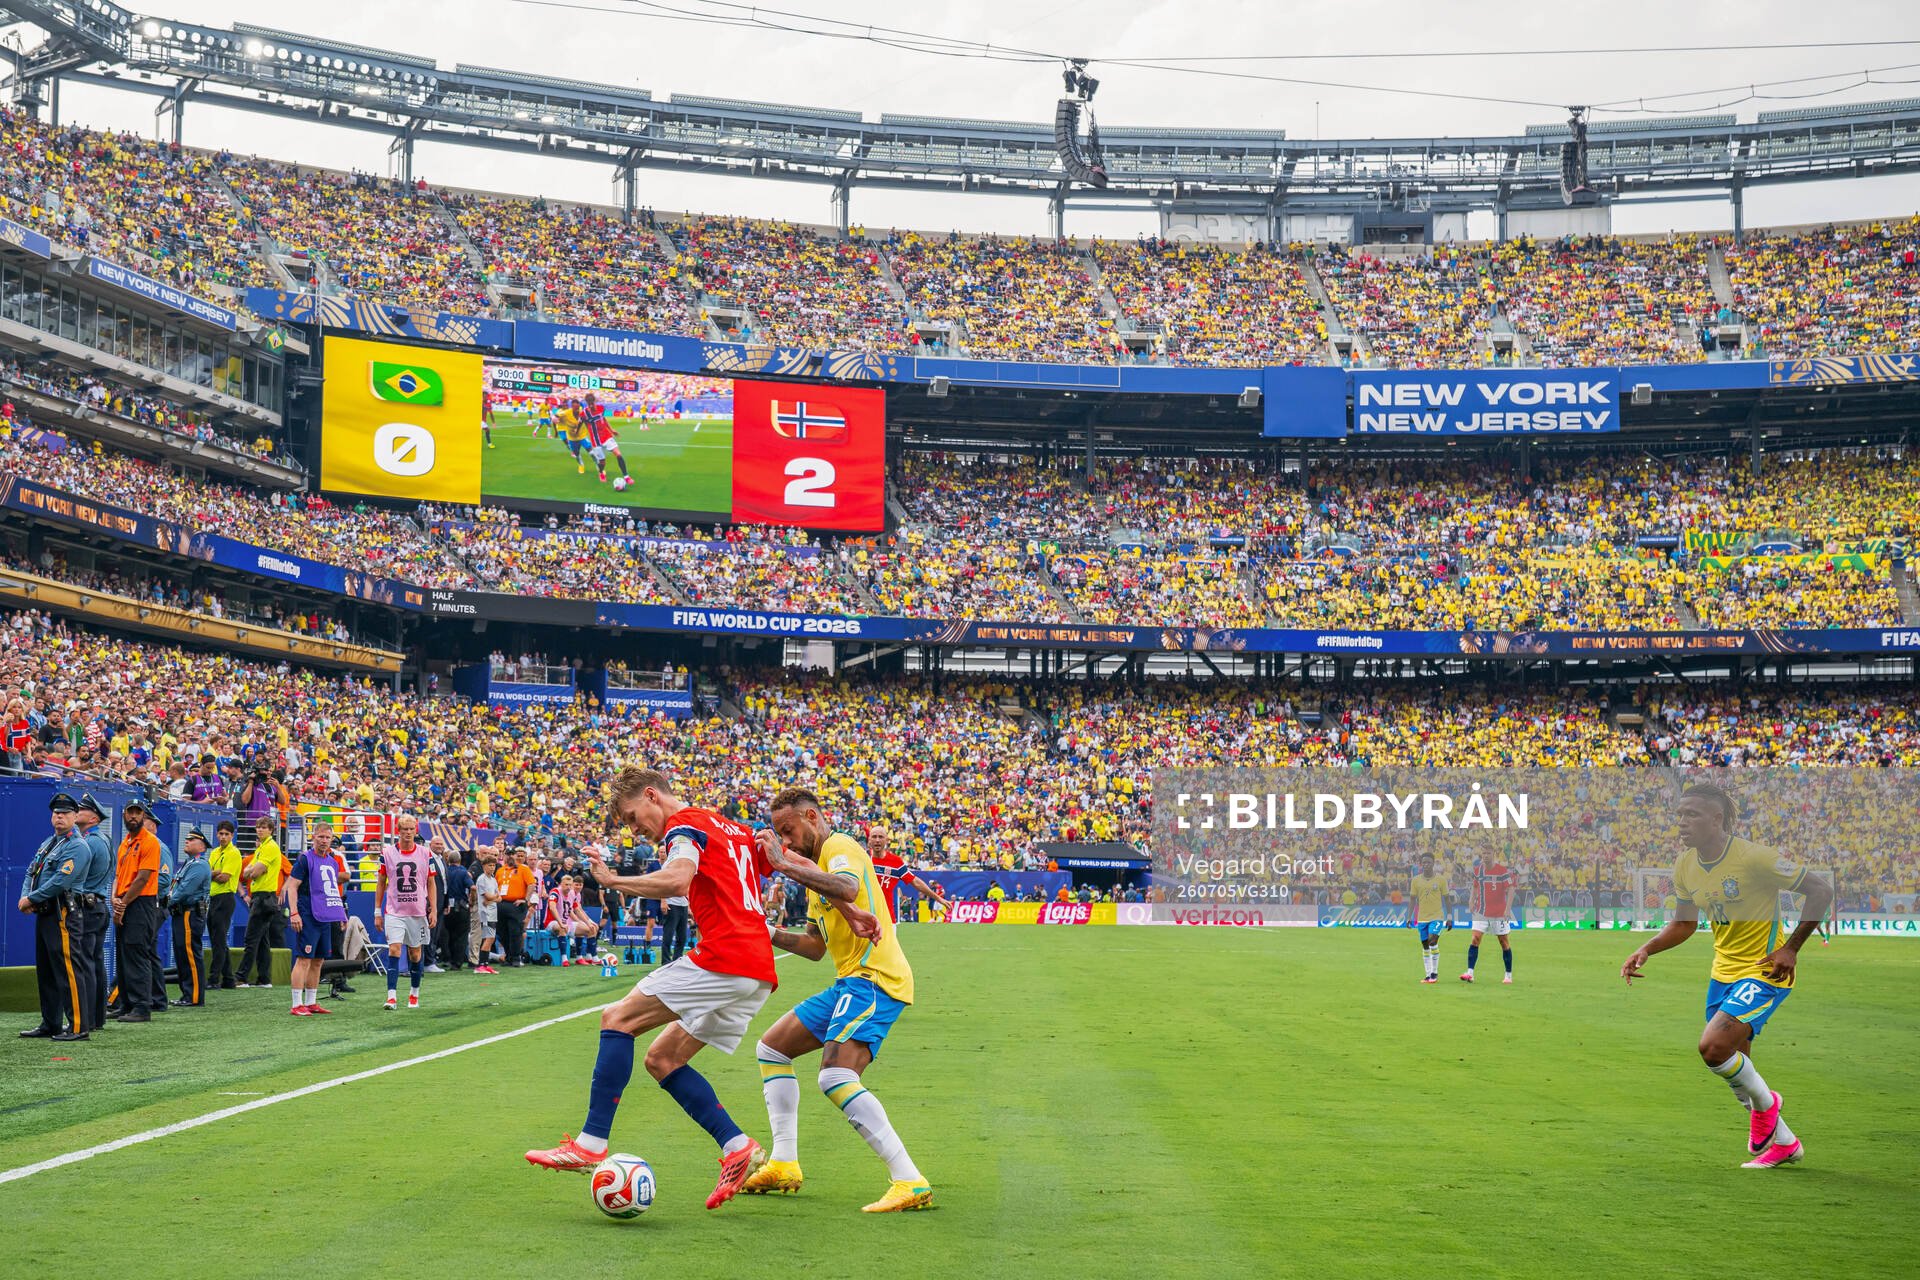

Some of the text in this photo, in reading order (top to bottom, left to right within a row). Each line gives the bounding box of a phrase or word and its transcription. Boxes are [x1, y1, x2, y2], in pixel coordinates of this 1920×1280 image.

[97, 263, 230, 324] NEW YORK NEW JERSEY
[553, 332, 664, 362] #FIFAWorldCup
[497, 368, 524, 380] 90:00
[571, 377, 577, 385] 0
[592, 379, 597, 387] 2
[497, 381, 513, 389] 4:43
[515, 382, 525, 390] +7
[1359, 381, 1611, 405] NEW YORK
[1359, 411, 1611, 432] NEW JERSEY
[784, 457, 836, 508] 2
[20, 487, 45, 508] NEW
[46, 495, 73, 516] YORK
[75, 504, 98, 524] NEW
[584, 503, 630, 516] Hisense
[257, 554, 301, 579] #FIFAWorldCup
[405, 590, 423, 606] NEW
[432, 591, 455, 601] HALF.
[432, 603, 478, 614] 7 MINUTES.
[673, 611, 861, 634] FIFA WORLD CUP 2026
[977, 627, 1135, 643] NEW YORK NEW JERSEY
[1317, 635, 1383, 649] #FIFAWorldCup
[1572, 635, 1746, 649] NEW YORK NEW JERSEY
[1881, 631, 1920, 647] FIFA
[488, 691, 505, 700] FIFA
[505, 693, 532, 701] WORLD
[532, 694, 548, 702] CUP
[622, 698, 650, 706] WOLD
[650, 700, 666, 708] CUP
[666, 701, 692, 709] 2026
[880, 875, 891, 888] 14
[949, 901, 994, 924] Lay's
[1043, 901, 1087, 924] Lay's
[1171, 904, 1264, 926] verizon
[1320, 905, 1408, 928] Michelob
[1841, 918, 1918, 932] MERICA
[1733, 981, 1762, 1005] 18
